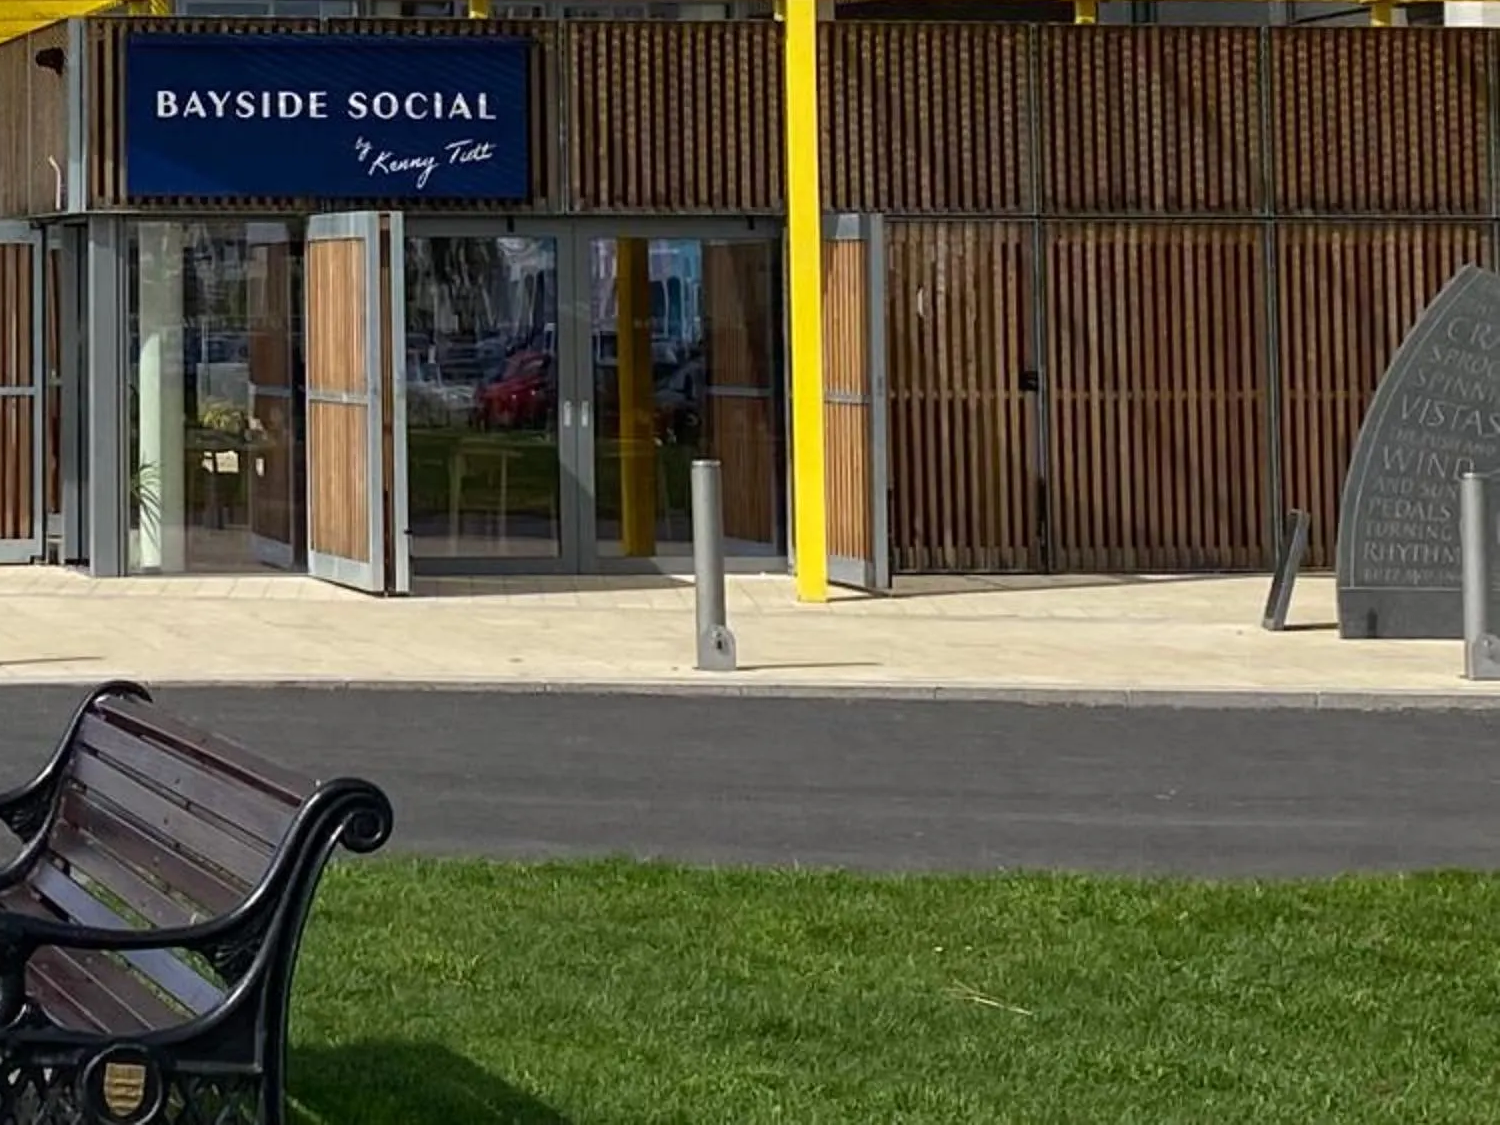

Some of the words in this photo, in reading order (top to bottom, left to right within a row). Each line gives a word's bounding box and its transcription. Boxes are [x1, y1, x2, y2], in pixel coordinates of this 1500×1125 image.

[156, 89, 329, 119] BAYSIDE
[347, 91, 497, 121] SOCIAL
[355, 135, 373, 162] by
[368, 151, 440, 189] Kenny
[1383, 443, 1475, 483] WIND
[1371, 474, 1414, 495] AND
[1367, 495, 1453, 523] PEDALS
[1364, 518, 1453, 544] TURNING
